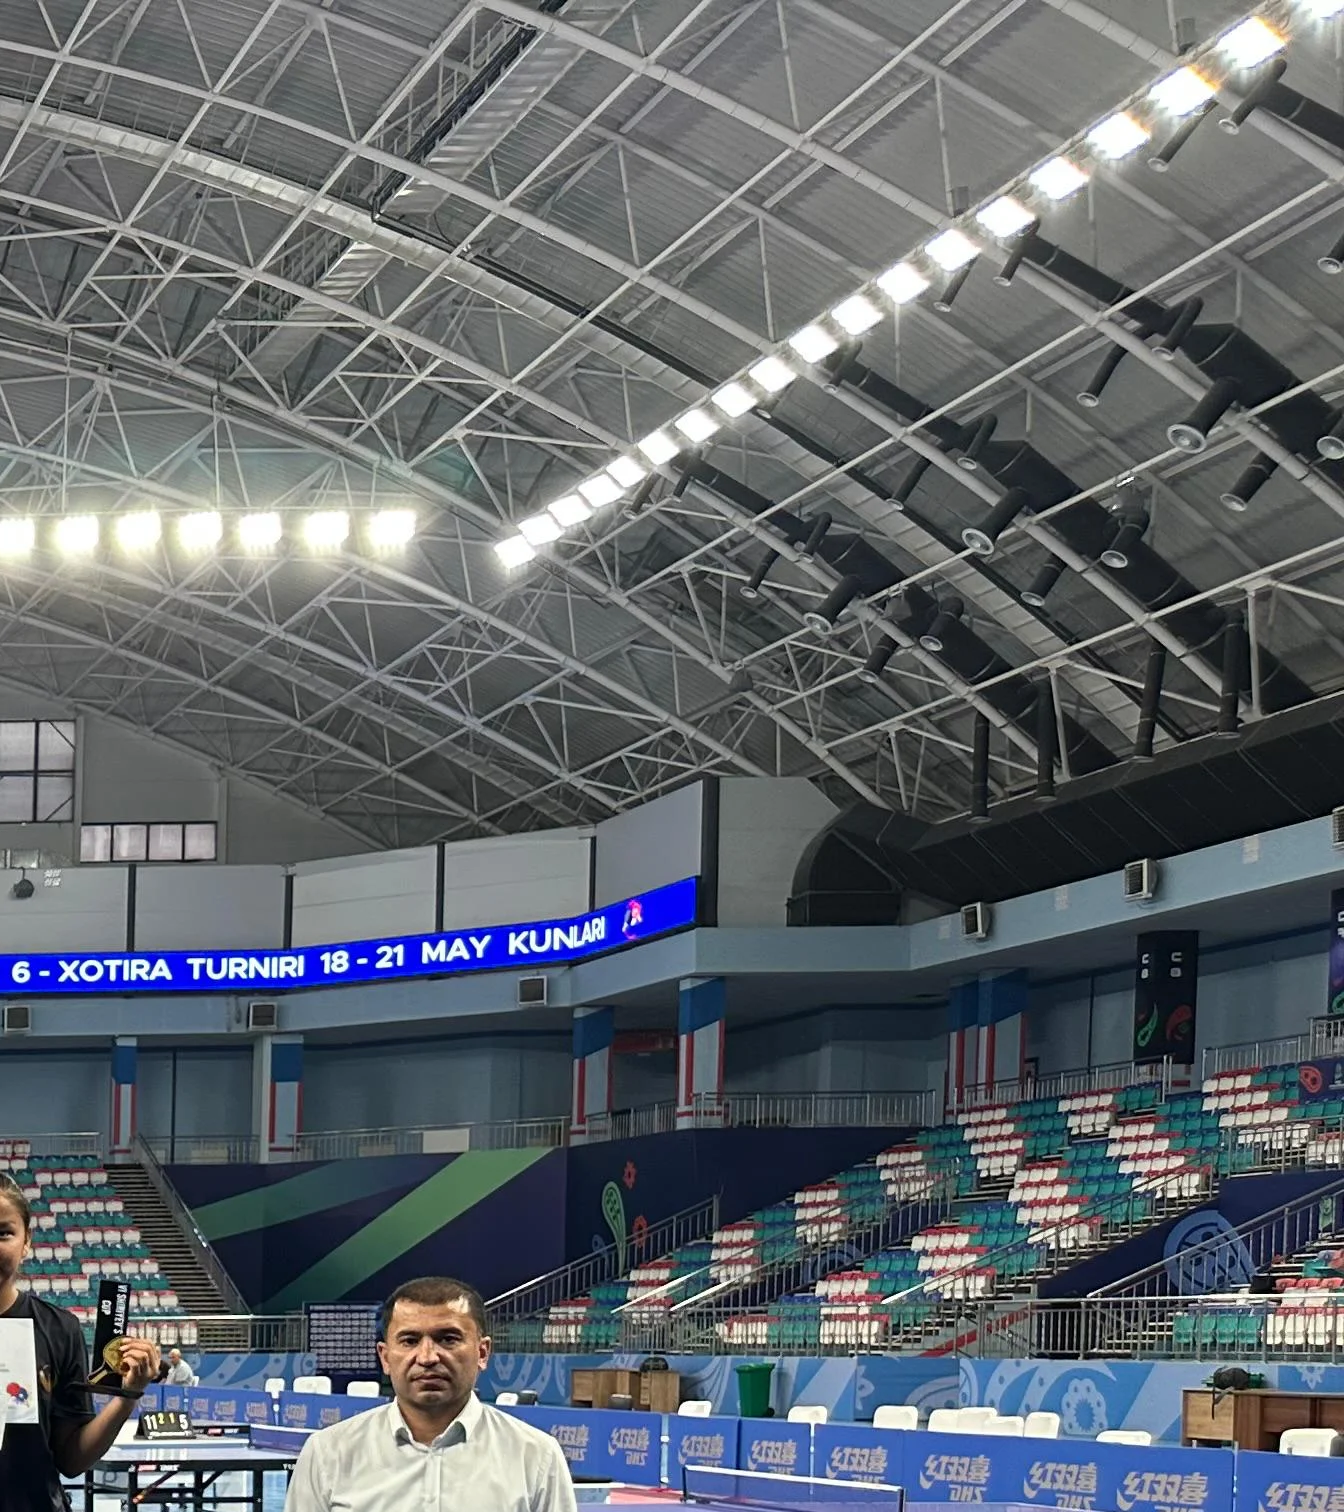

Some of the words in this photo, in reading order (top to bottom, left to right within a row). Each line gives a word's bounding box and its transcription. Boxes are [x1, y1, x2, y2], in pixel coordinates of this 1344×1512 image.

[12, 961, 32, 985] 6
[58, 955, 173, 983] XOTIRA
[189, 954, 305, 981] TURNIRI
[319, 950, 350, 975] 18
[375, 945, 404, 970] 21
[420, 935, 492, 965] MAY
[508, 916, 606, 957] KUNLARI
[144, 1414, 158, 1431] 11
[157, 1412, 164, 1424] 2
[169, 1412, 175, 1424] 1
[178, 1413, 188, 1431] 5
[919, 1454, 991, 1490] 红双喜
[1023, 1461, 1097, 1500] 红双喜
[948, 1484, 987, 1504] DHS
[1116, 1472, 1209, 1511] 红双喜
